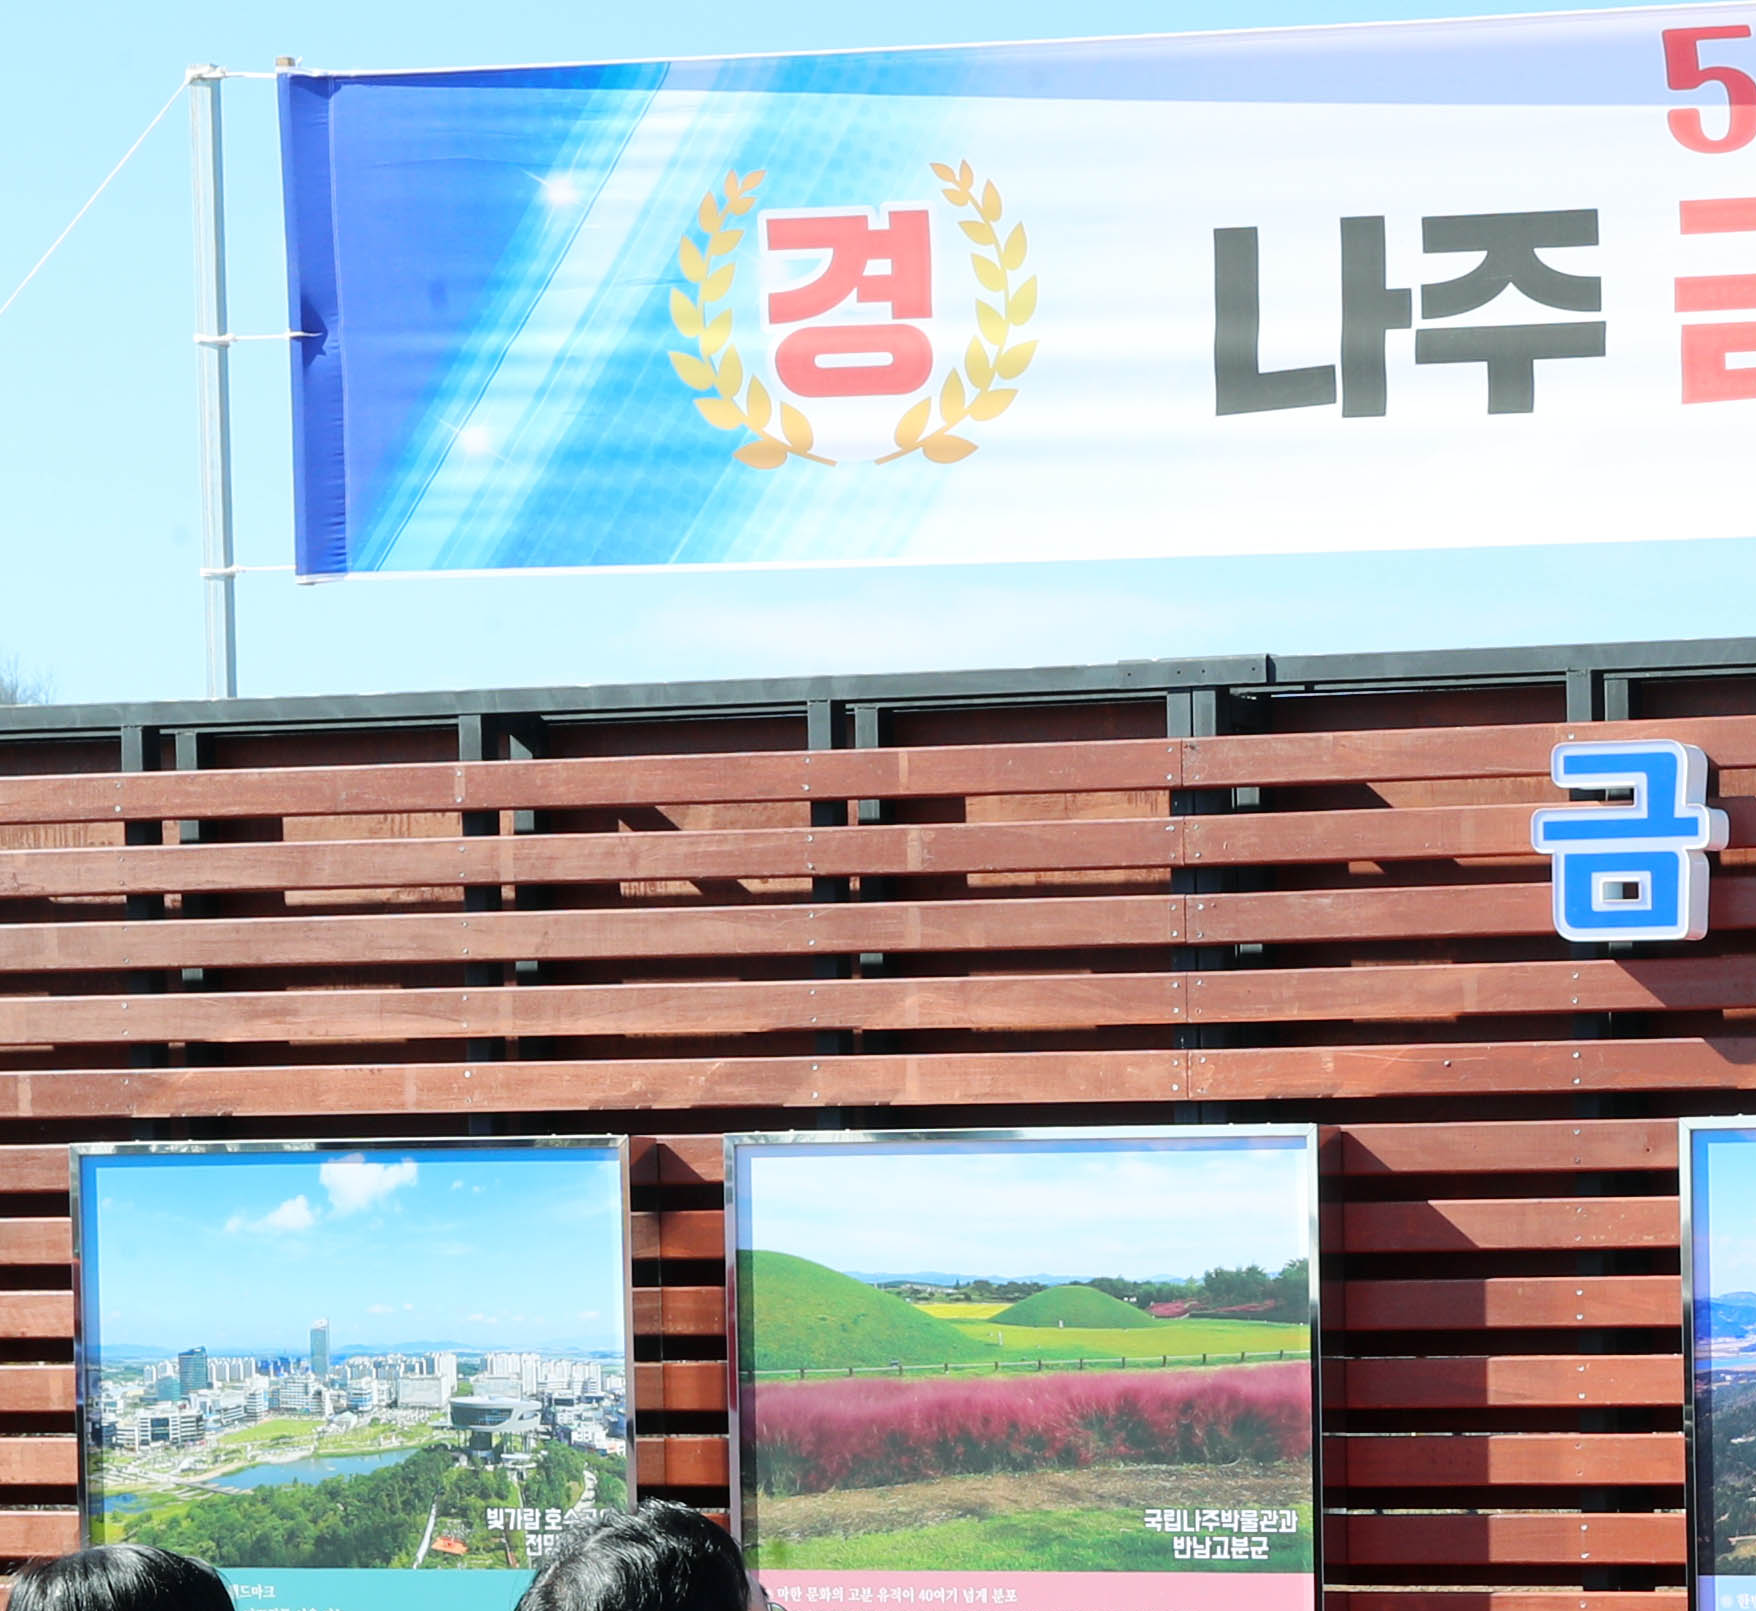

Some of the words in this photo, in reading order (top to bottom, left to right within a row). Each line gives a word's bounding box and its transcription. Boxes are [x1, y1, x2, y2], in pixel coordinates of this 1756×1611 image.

[766, 208, 934, 398] 경
[1212, 207, 1606, 418] 나주
[486, 1507, 541, 1531] 빛가람
[1144, 1508, 1298, 1533] 국립나주박물관과
[1172, 1536, 1270, 1560] 반남고분군
